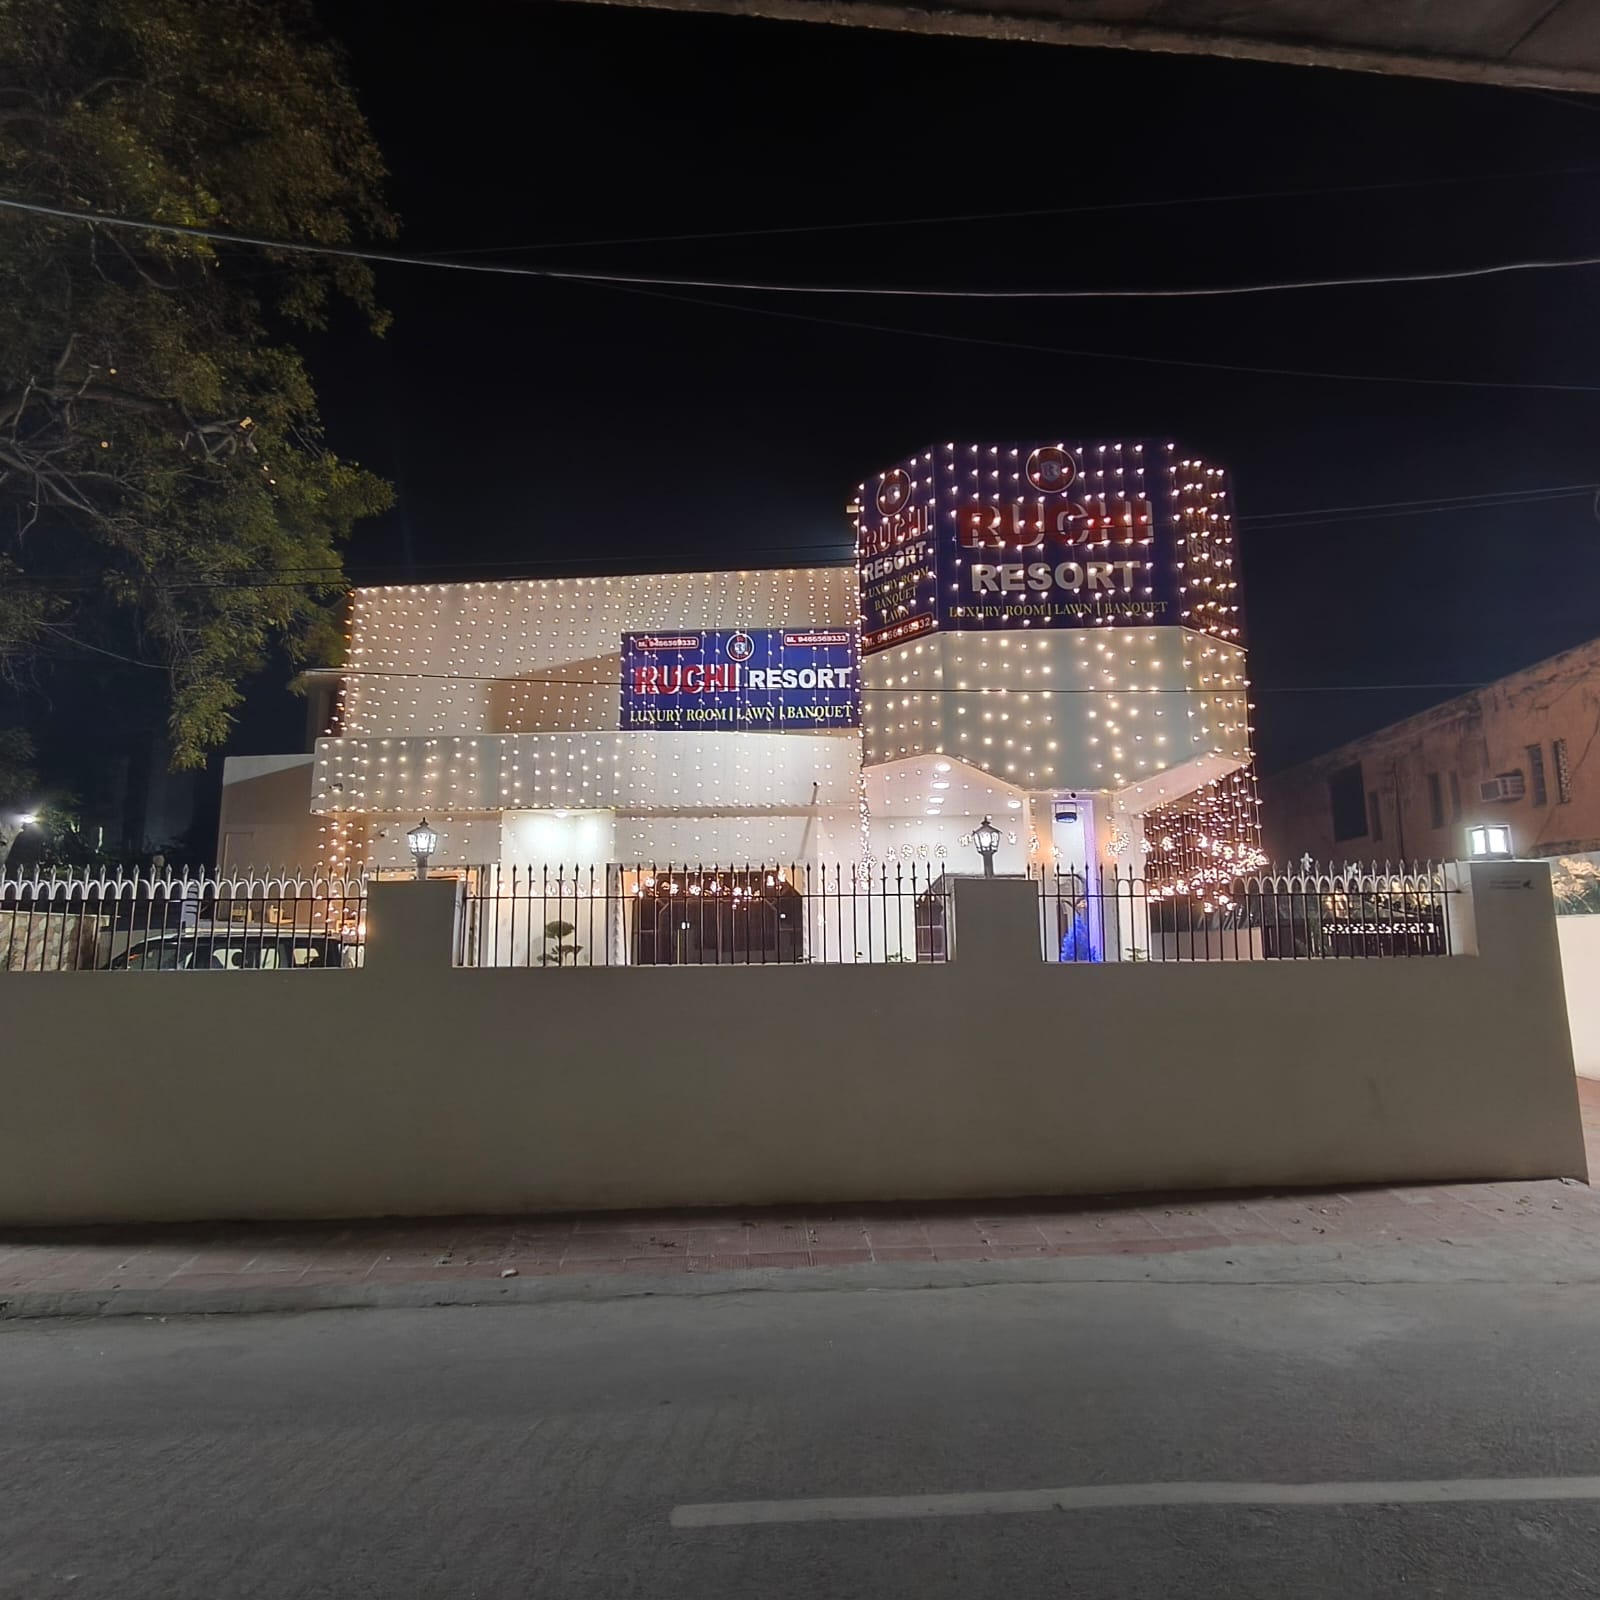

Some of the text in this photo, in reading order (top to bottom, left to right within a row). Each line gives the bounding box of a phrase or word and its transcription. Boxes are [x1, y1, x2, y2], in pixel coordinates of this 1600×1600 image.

[863, 505, 929, 558] RUCHI
[958, 500, 1154, 549] RUCHI
[864, 541, 926, 583] RESORT
[971, 561, 1141, 592] RESORT
[862, 577, 901, 600] LUXRY
[949, 601, 1169, 618] LUXURY ROOM LAWN BANQUET
[634, 663, 851, 694] RUCHI RESORT
[629, 704, 854, 722] LUXURY ROOM LAWN BANQUET
